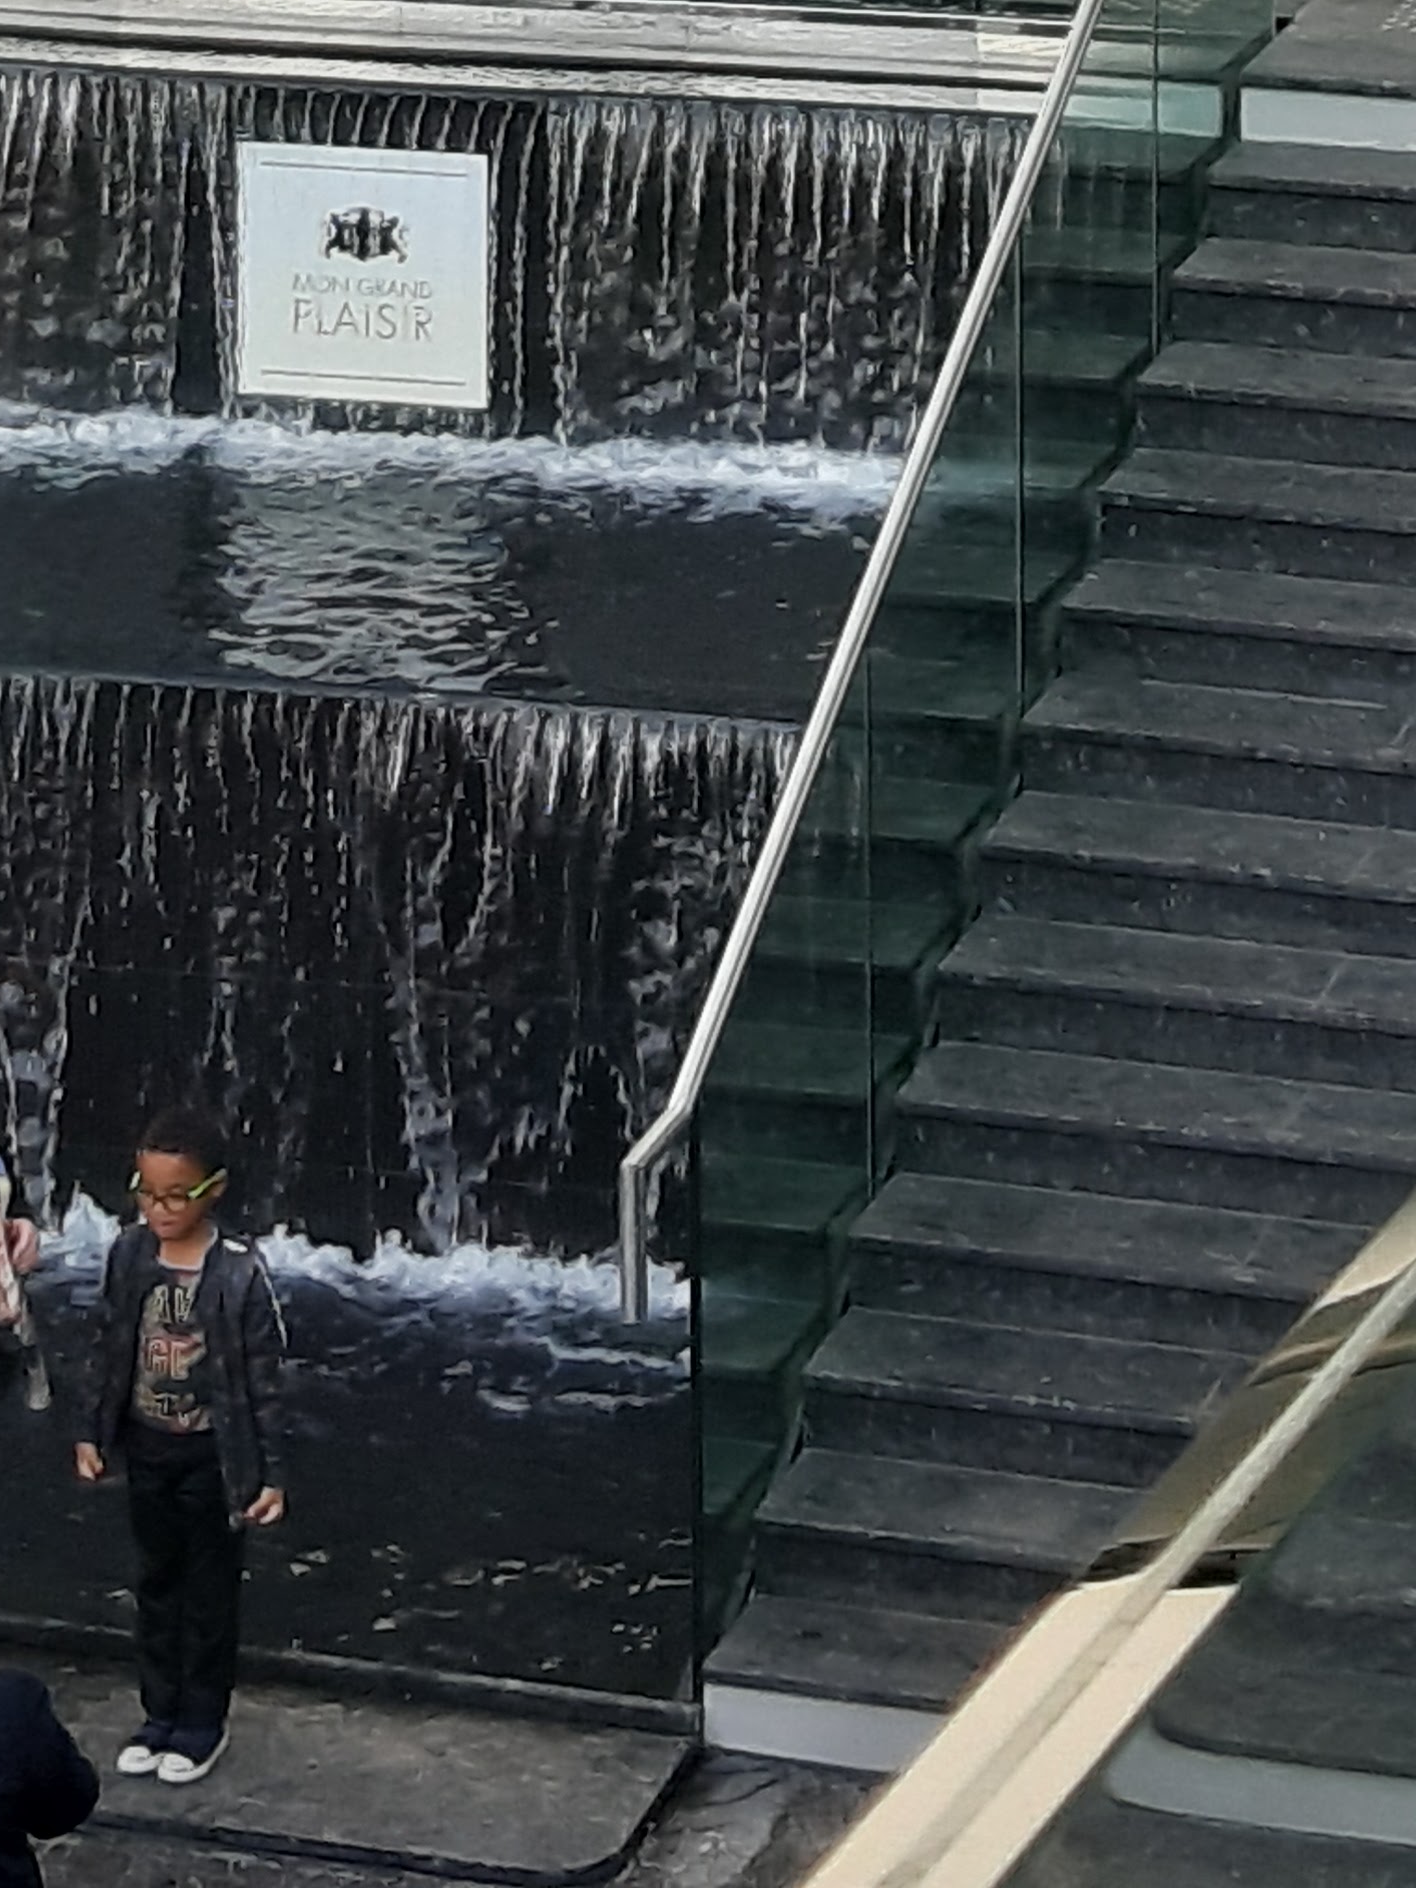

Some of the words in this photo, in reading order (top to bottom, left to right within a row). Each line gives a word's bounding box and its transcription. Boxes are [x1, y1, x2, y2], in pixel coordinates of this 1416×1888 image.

[292, 274, 350, 293] MON
[356, 278, 433, 299] GRAND
[292, 298, 433, 342] PLAISIR
